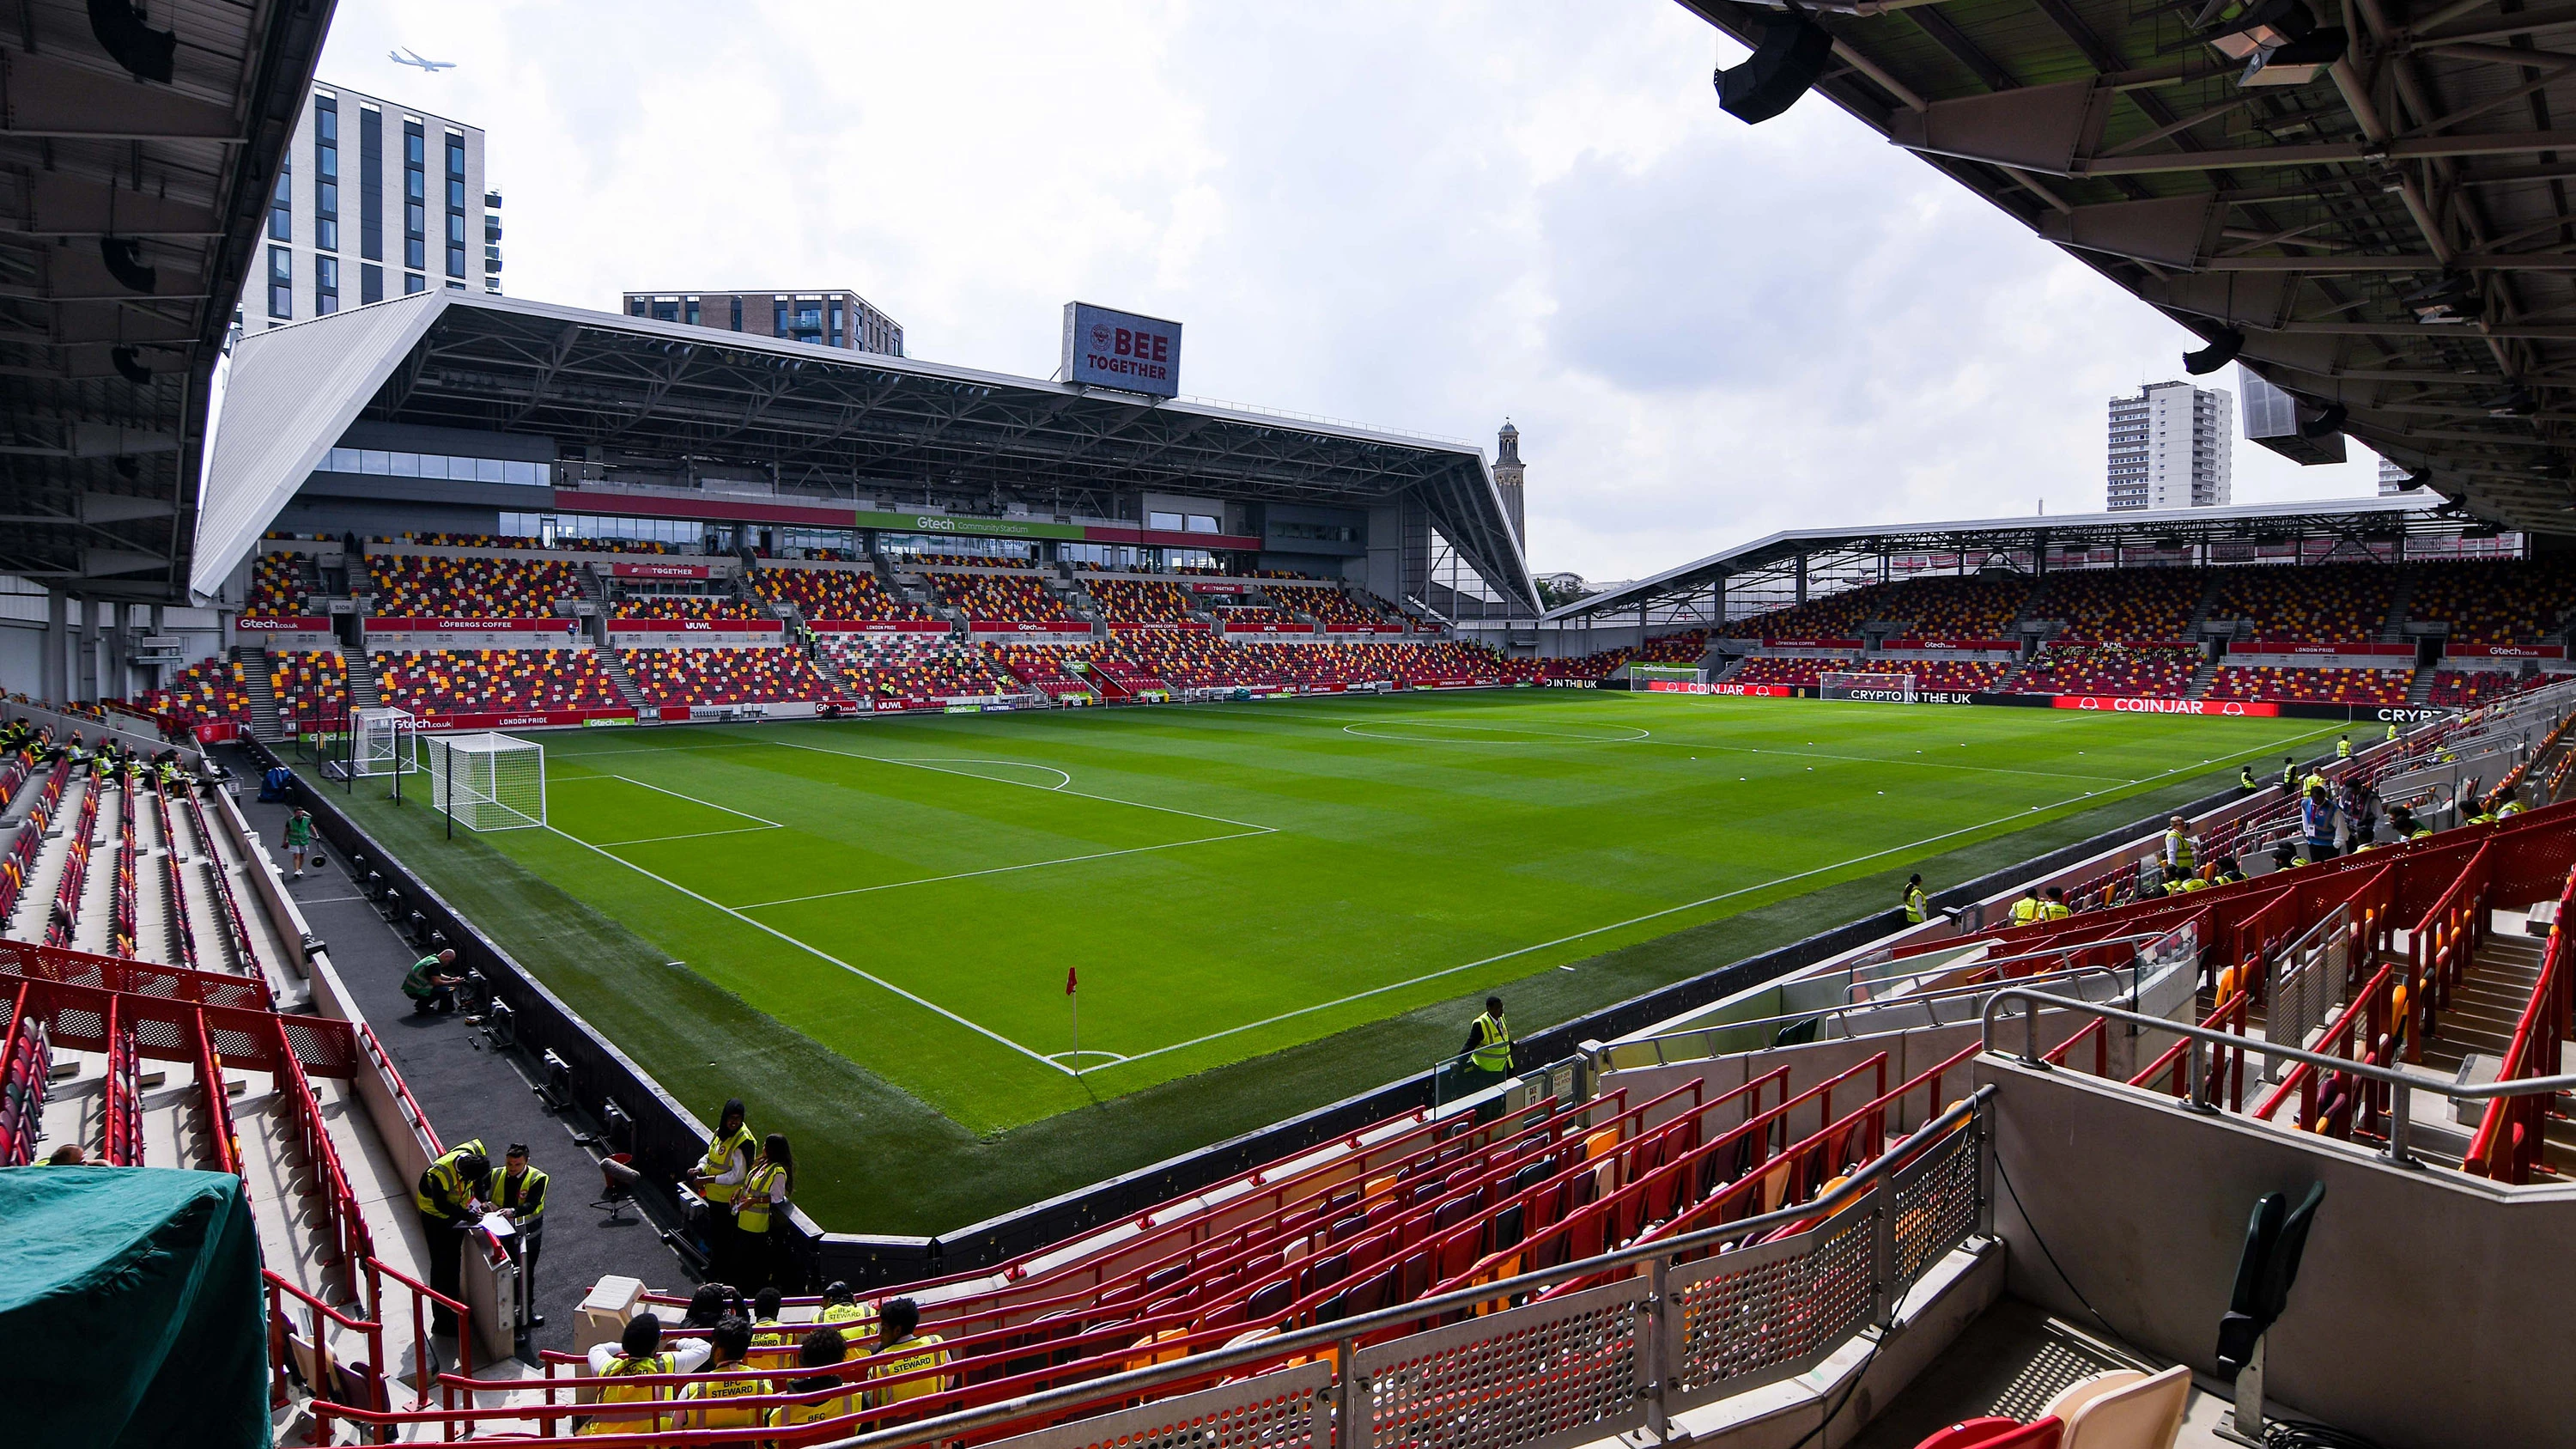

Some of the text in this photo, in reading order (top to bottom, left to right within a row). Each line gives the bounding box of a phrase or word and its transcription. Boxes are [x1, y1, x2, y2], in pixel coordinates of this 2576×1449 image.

[1115, 327, 1168, 362] BEE
[1087, 354, 1166, 380] TOGETHER
[917, 516, 1028, 533] Gtech Community Stadium
[631, 567, 693, 575] #TOGETHER
[240, 619, 298, 629] Gtech.co.uk
[2490, 647, 2539, 656] Gtech.co.uk
[1564, 679, 1583, 688] TH
[1583, 679, 1597, 688] UK
[1687, 683, 1745, 696] COINJAR
[1850, 689, 1971, 704] CRYPTO IN THE UK
[2113, 698, 2203, 715] COINJAR
[829, 1311, 861, 1320] STEWARD
[894, 1356, 931, 1373] STEWARD
[712, 1385, 753, 1398] STEWARD
[807, 1412, 825, 1422] BFC
